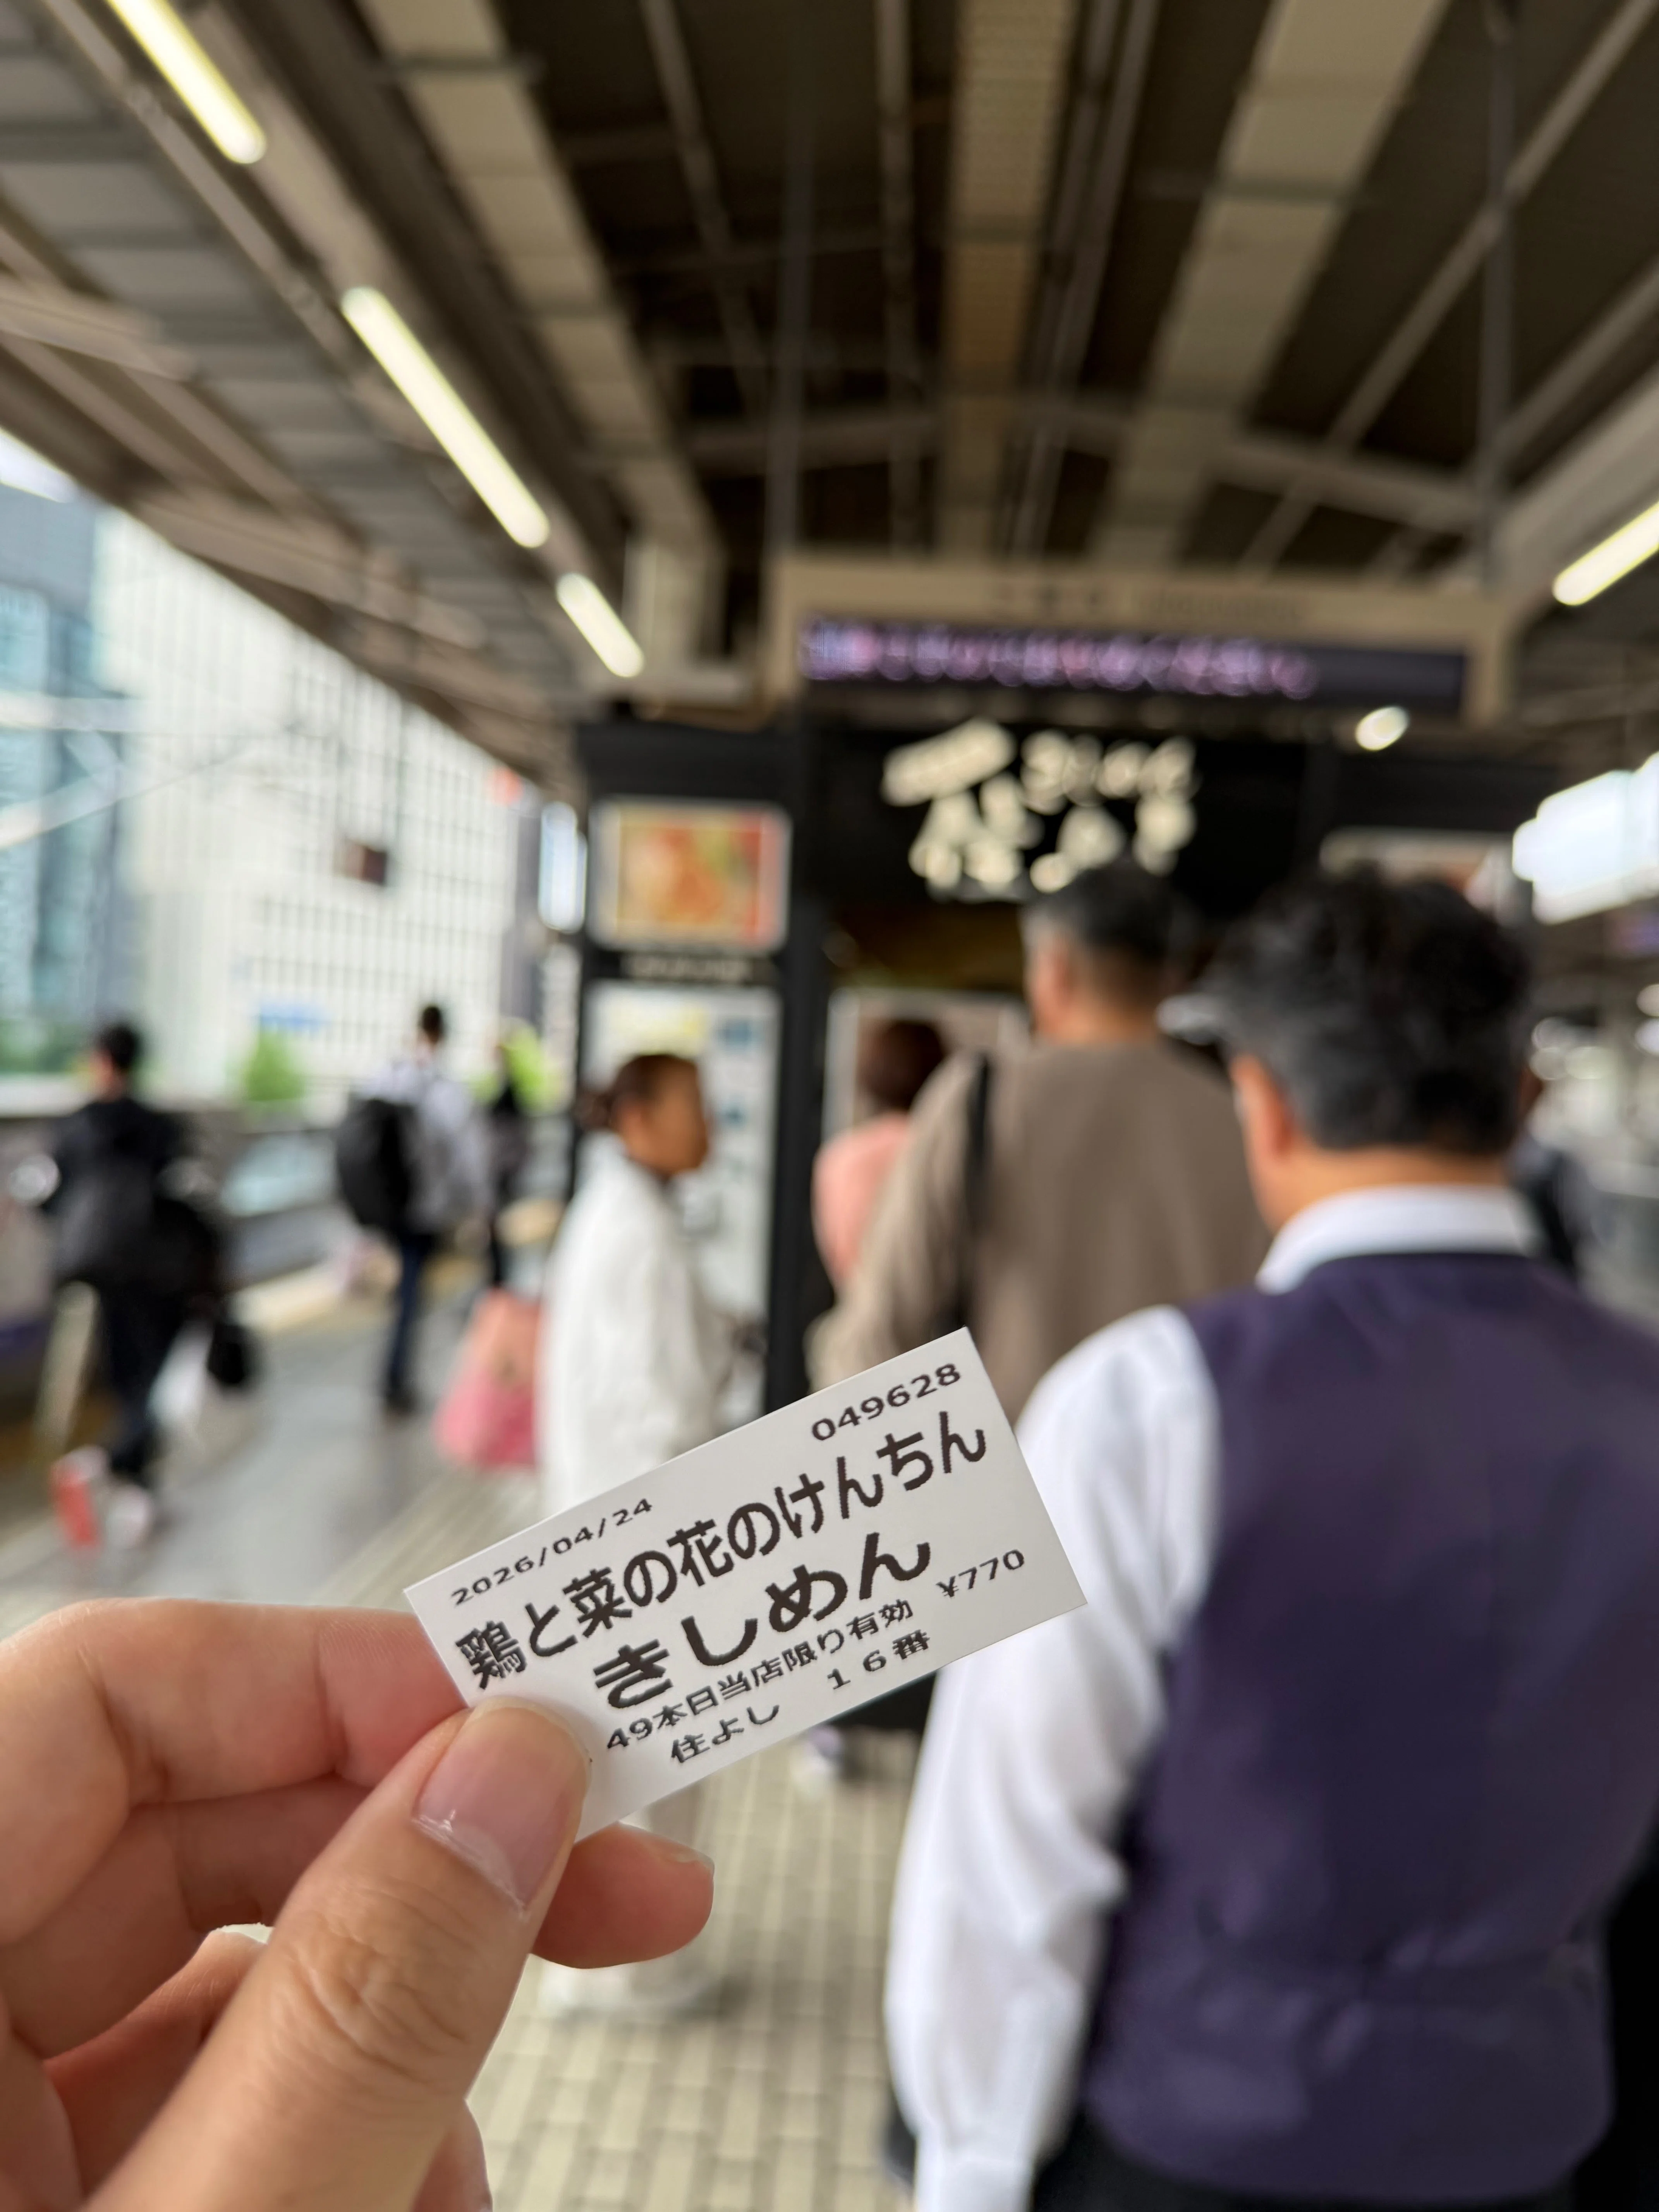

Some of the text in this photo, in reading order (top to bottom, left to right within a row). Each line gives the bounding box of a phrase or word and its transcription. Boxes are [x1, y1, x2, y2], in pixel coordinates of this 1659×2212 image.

[811, 1364, 961, 1441] 049628
[452, 1499, 652, 1605] 2026/04/24
[455, 1411, 987, 1690] 鶏と菜の花のけんちん
[936, 1549, 1025, 1598] ¥770
[593, 1532, 931, 1709] きしめん
[606, 1599, 914, 1750] 49本日当店限り有効
[671, 1705, 779, 1764] 住よし
